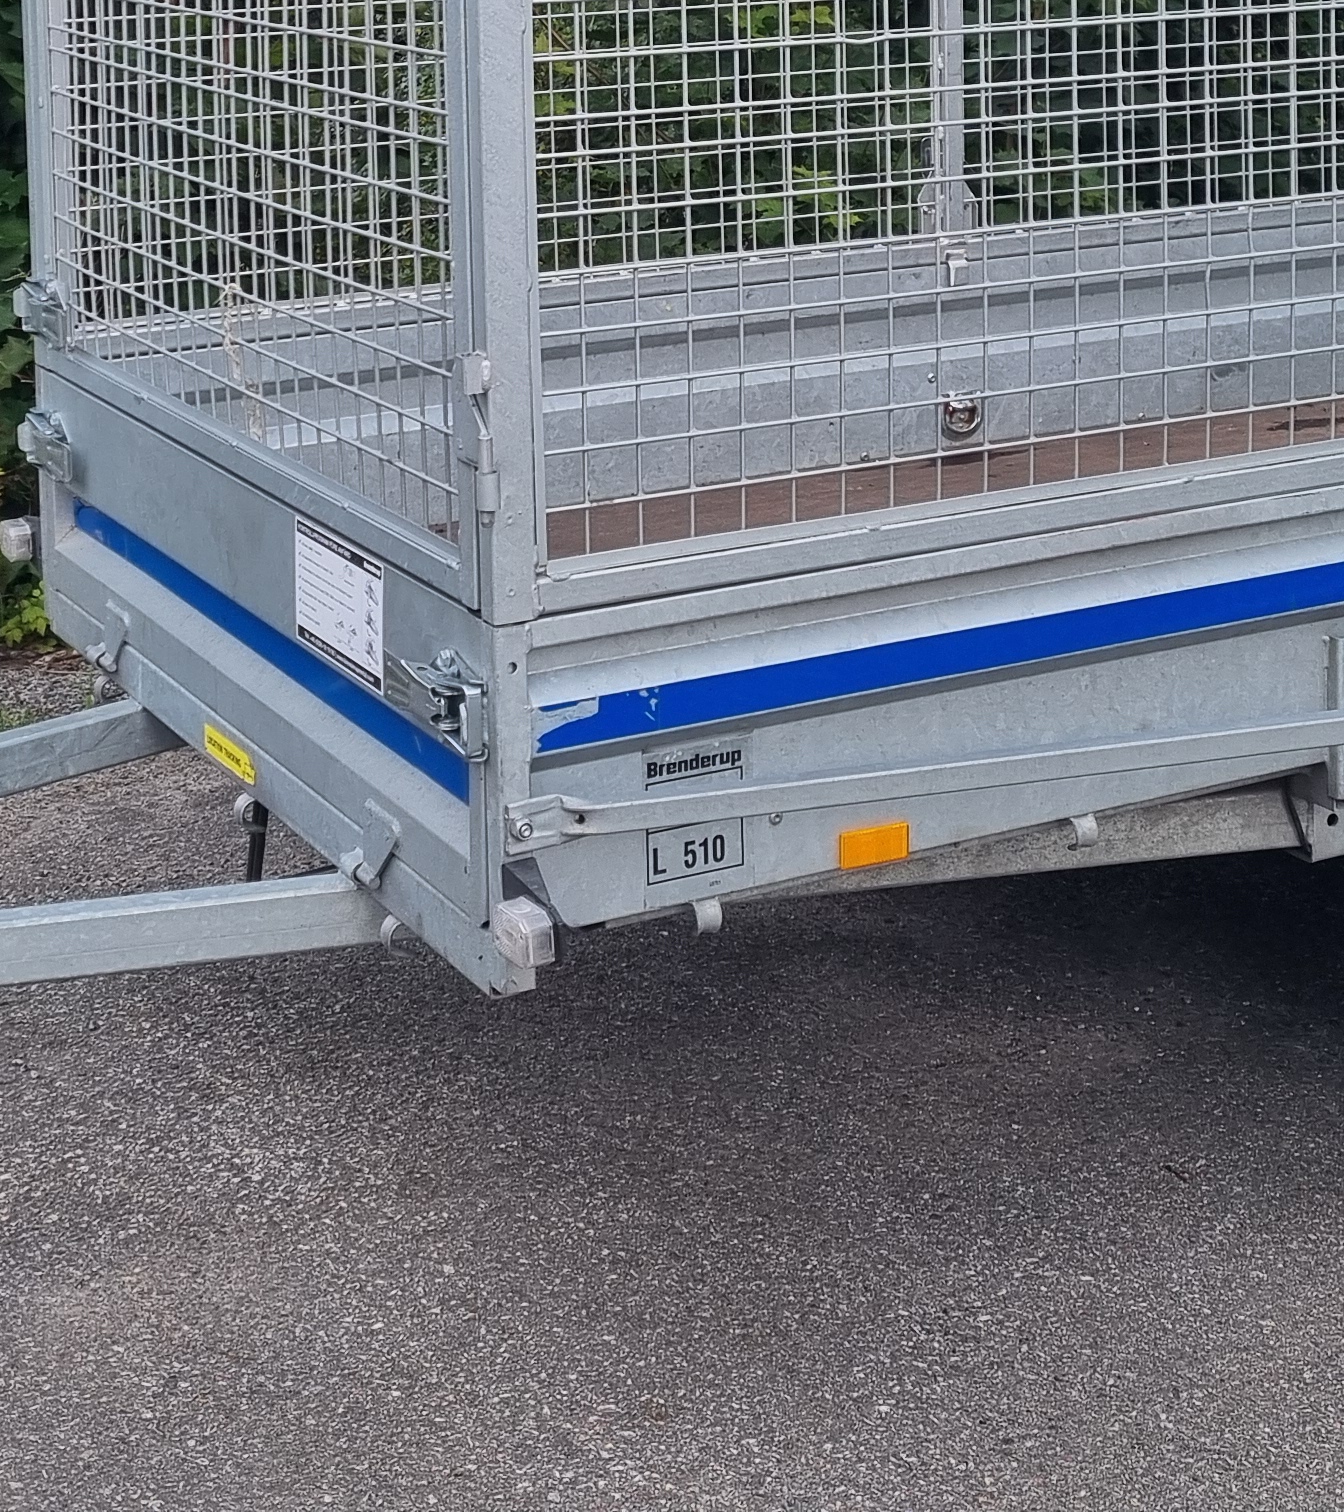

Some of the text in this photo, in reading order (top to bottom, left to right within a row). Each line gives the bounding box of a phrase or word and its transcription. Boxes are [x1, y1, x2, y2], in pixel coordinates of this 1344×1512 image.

[646, 749, 742, 779] Brenderup
[652, 834, 725, 875] L 510
